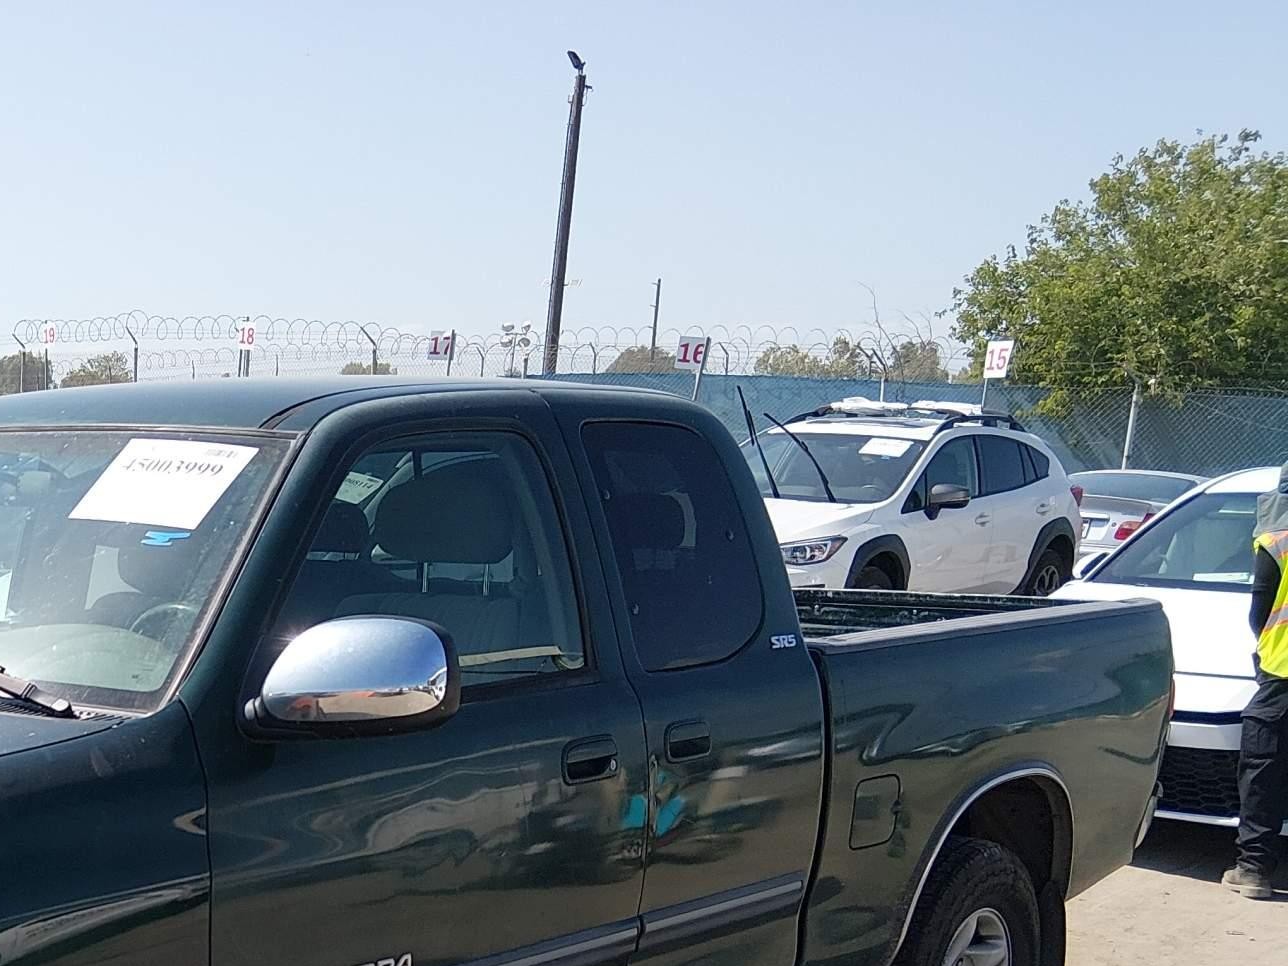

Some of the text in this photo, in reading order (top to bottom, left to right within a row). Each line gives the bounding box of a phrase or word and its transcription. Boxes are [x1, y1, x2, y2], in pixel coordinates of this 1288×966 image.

[44, 327, 55, 344] 19
[239, 327, 255, 345] 18
[429, 336, 451, 355] 17
[677, 343, 705, 364] 16
[986, 348, 1010, 371] 15
[770, 634, 797, 649] SR5
